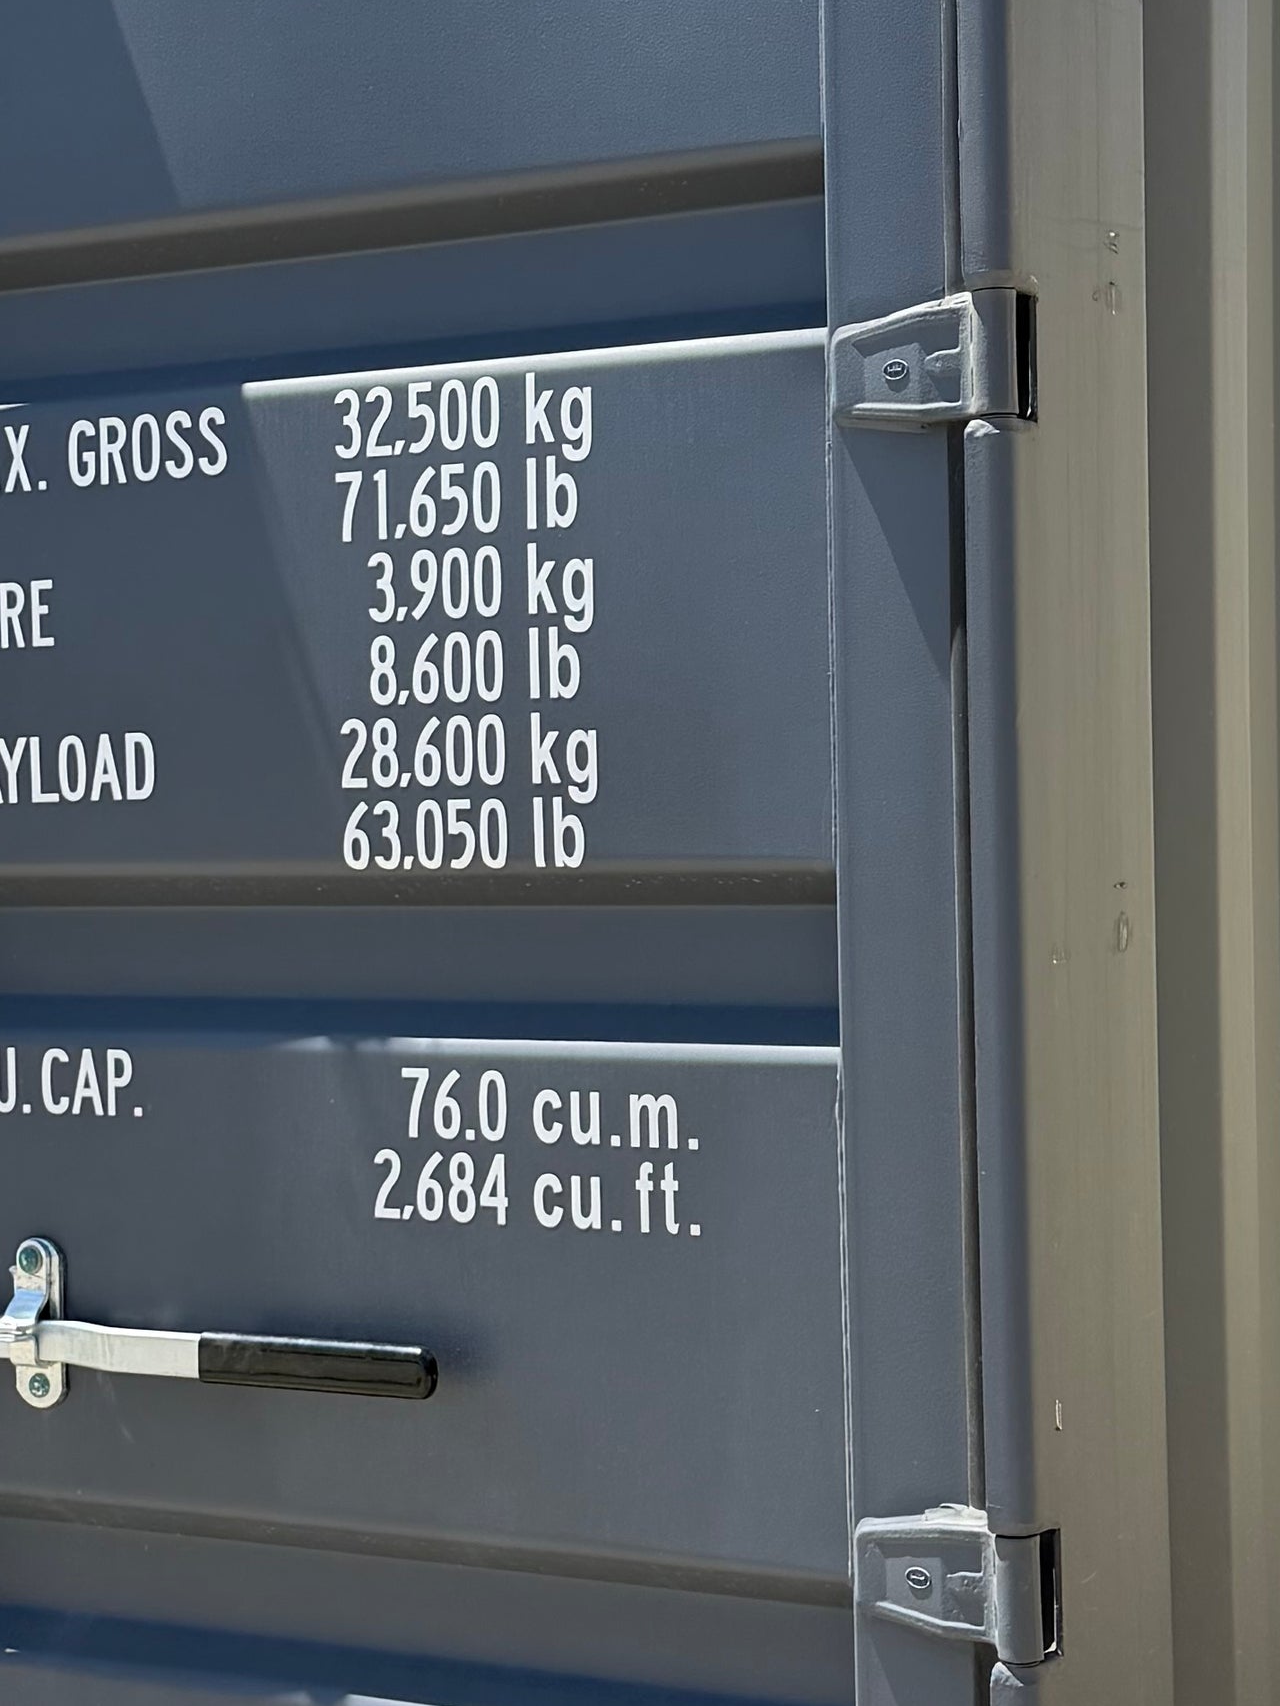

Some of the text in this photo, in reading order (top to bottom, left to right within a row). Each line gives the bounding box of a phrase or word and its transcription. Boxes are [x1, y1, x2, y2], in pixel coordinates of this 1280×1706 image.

[67, 405, 229, 488] GROSS
[333, 374, 502, 459] 32,500
[524, 371, 593, 461] kg
[334, 456, 580, 543] 71,650 lb
[366, 544, 503, 625] 3,900
[526, 542, 595, 634] kg
[368, 626, 583, 706] 8,600 lb
[339, 713, 507, 790] 28,600
[530, 711, 599, 804] kg
[342, 796, 587, 872] 63,050 lb
[400, 1066, 508, 1143] 76.0
[531, 1088, 700, 1152] cu.m.
[372, 1147, 702, 1238] 2,684 cu.ft.
